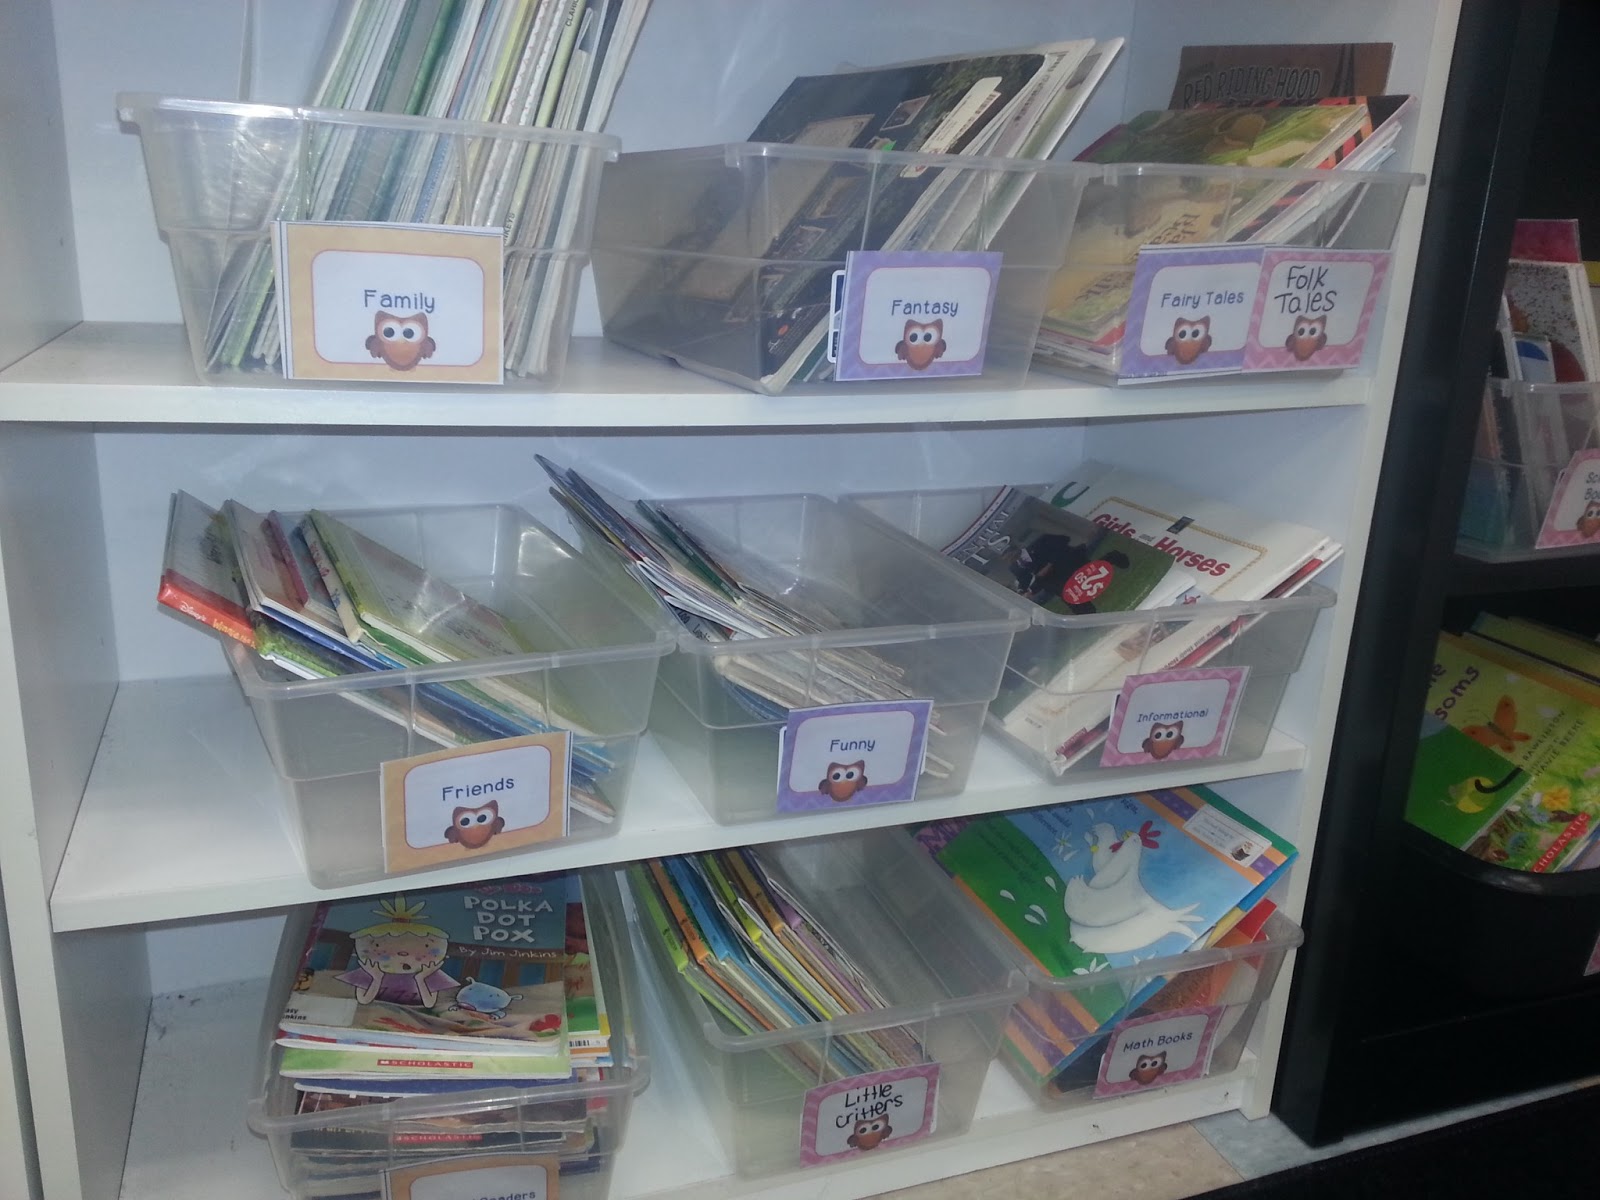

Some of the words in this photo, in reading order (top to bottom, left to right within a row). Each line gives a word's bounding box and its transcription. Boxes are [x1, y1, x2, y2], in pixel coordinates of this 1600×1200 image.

[1216, 64, 1274, 99] RIDING
[1273, 66, 1322, 99] HOOD
[1286, 265, 1328, 291] Folk
[363, 289, 435, 314] Family
[891, 299, 959, 318] Fantasy
[1160, 292, 1200, 309] Fairy
[1206, 291, 1245, 305] Tales
[1274, 290, 1338, 314] Tales
[1153, 536, 1231, 577] Horses
[1137, 708, 1209, 723] Informational
[829, 739, 876, 753] Funny
[442, 777, 515, 801] Friends
[1533, 813, 1588, 873] CHOLASTIC
[463, 895, 553, 913] POLKA
[477, 911, 536, 927] DOT
[472, 925, 535, 943] POX
[459, 946, 477, 956] By
[481, 947, 506, 957] Jim
[509, 949, 557, 959] Jinkins
[1123, 1037, 1154, 1053] Math
[1157, 1031, 1193, 1046] Books
[390, 1060, 472, 1068] SCHOLASTIC
[844, 1083, 893, 1108] Little
